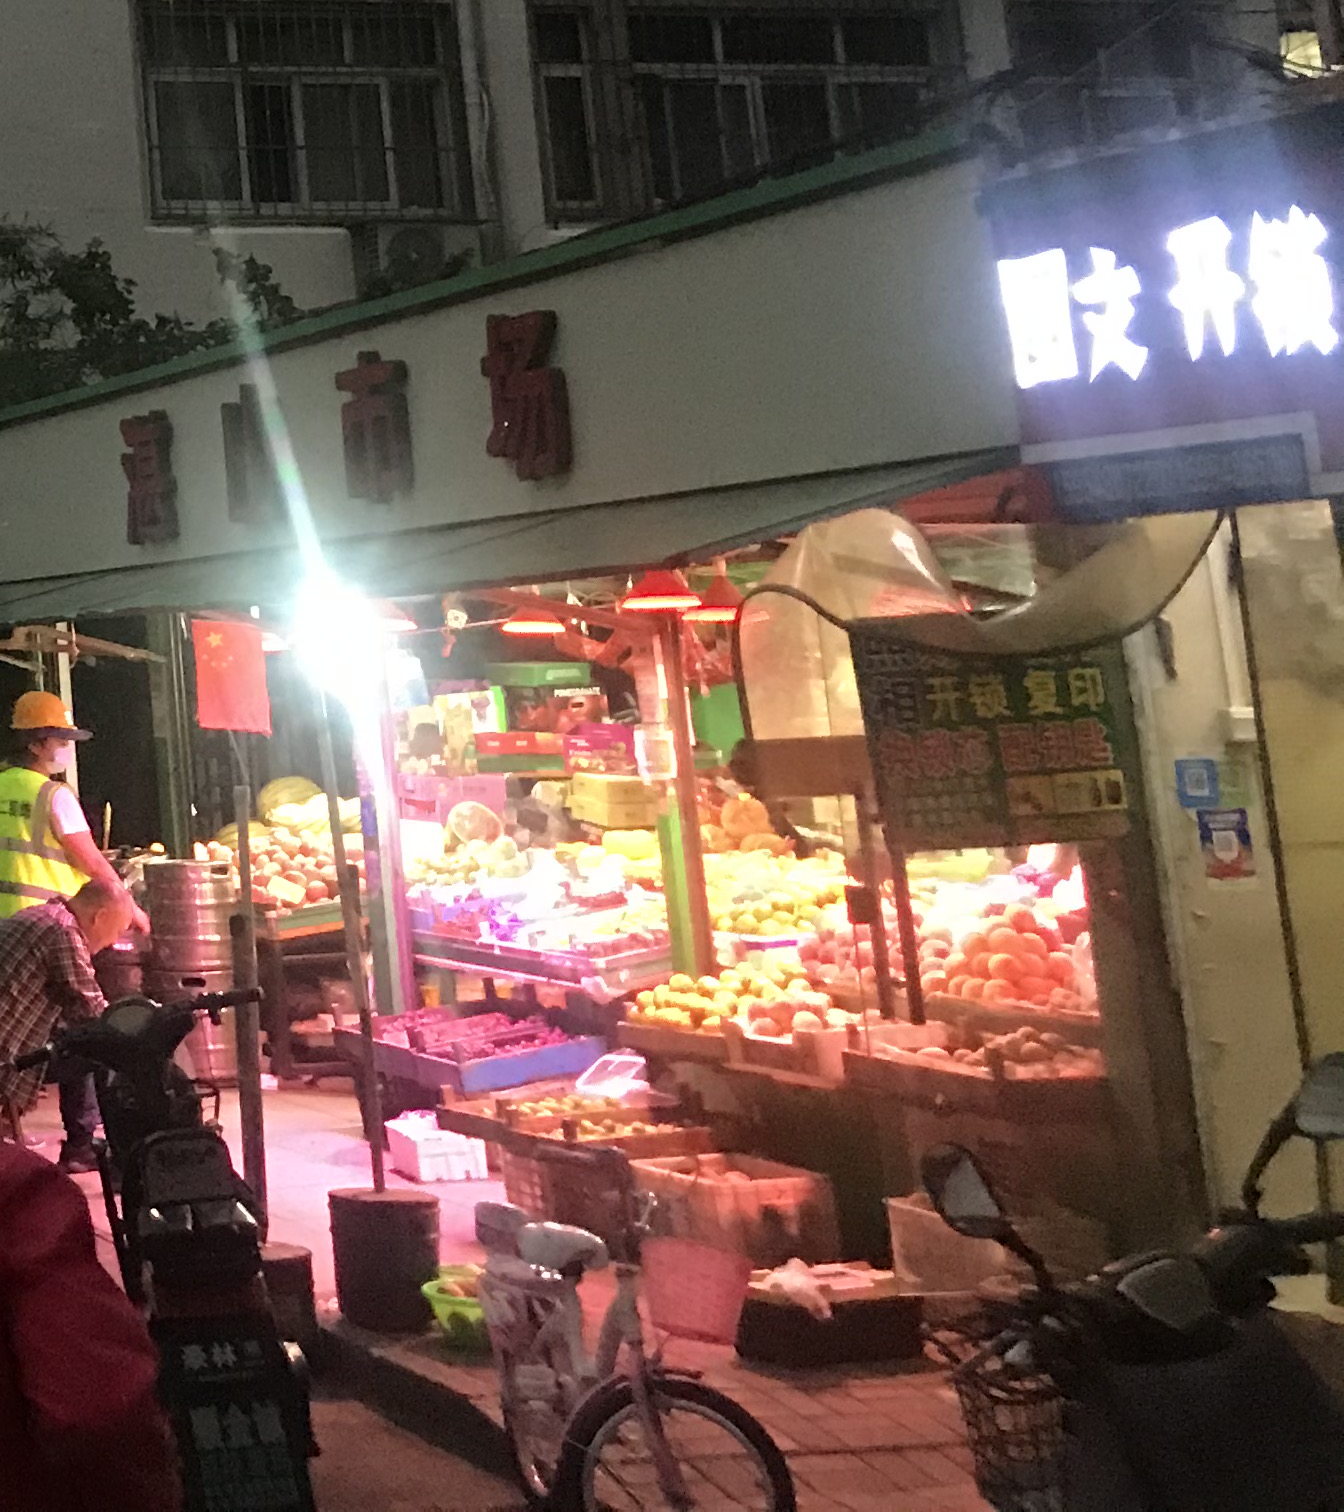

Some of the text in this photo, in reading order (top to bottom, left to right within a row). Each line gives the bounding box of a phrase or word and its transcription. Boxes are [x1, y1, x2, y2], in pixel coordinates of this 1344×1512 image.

[924, 666, 1106, 722] 开锁 复印
[997, 717, 1115, 772] 配钥匙
